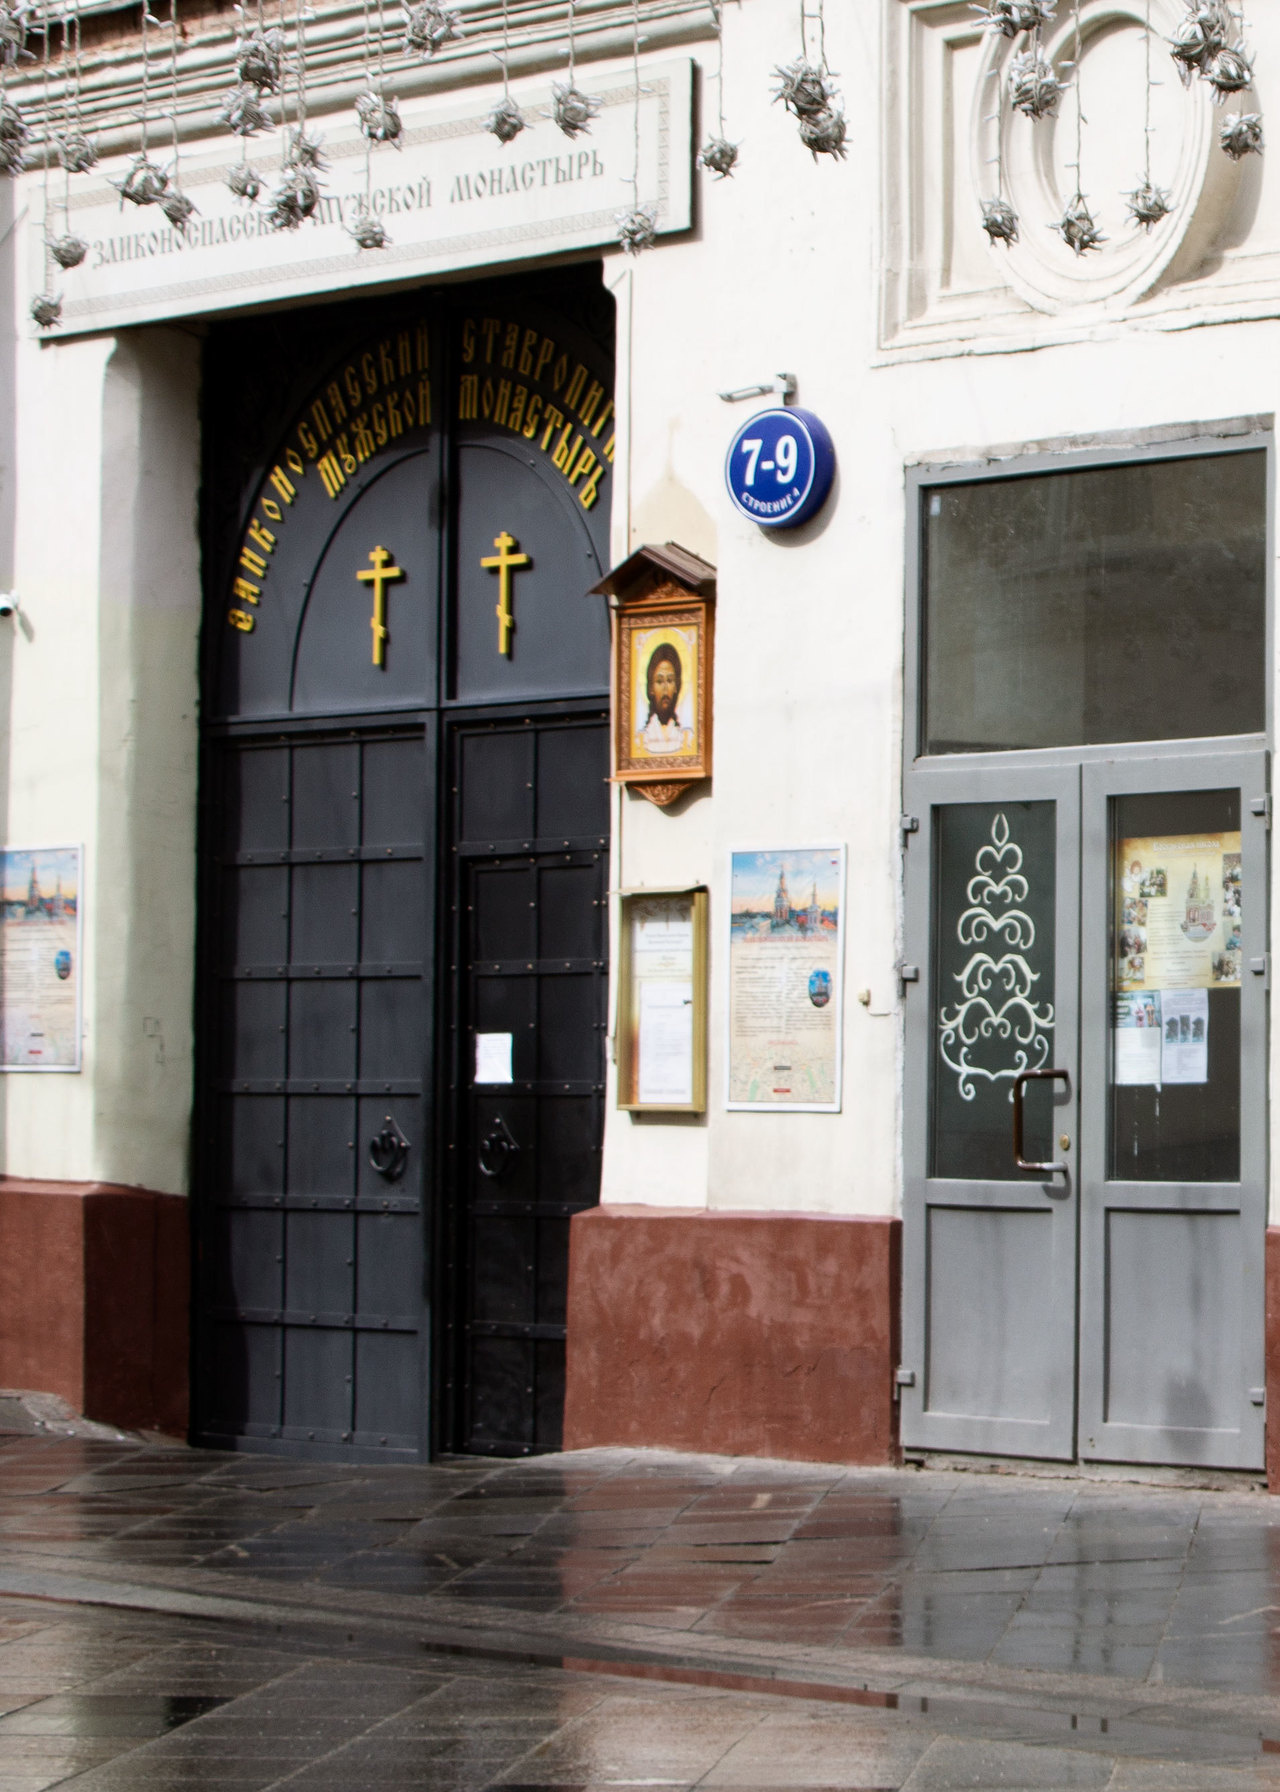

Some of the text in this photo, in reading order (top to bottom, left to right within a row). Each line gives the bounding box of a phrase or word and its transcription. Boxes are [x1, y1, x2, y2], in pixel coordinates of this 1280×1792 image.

[450, 149, 604, 204] МОНАСТЫРЬ
[458, 373, 605, 510] МОНАСТЫРЬ
[741, 435, 798, 486] 7-9
[742, 491, 793, 512] СТРОЕНИЕ
